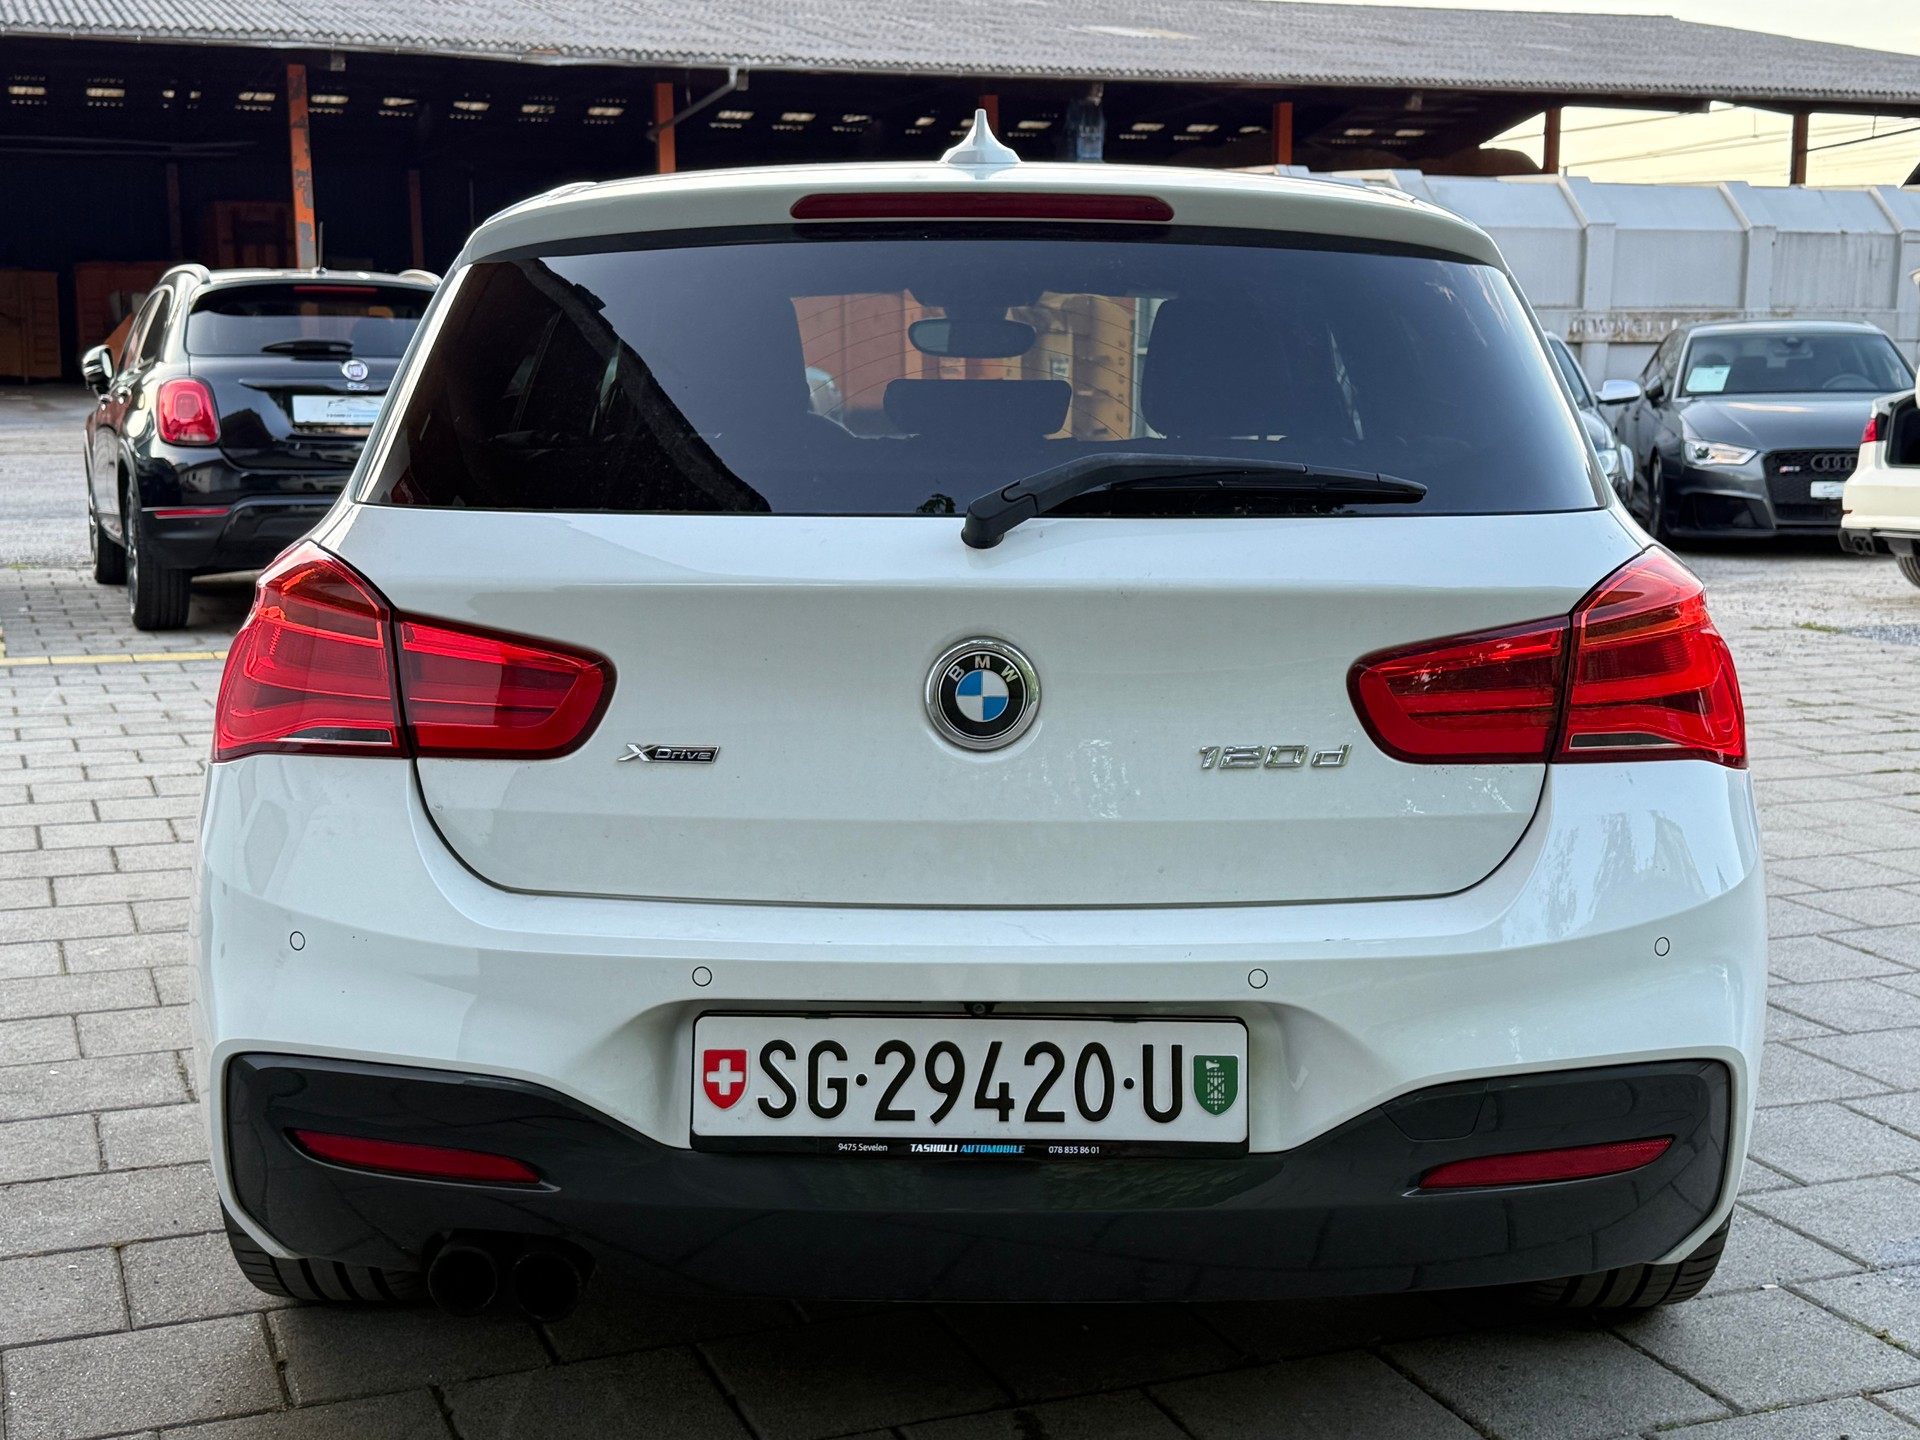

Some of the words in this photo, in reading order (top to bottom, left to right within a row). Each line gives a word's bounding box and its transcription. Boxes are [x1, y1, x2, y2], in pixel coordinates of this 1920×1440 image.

[948, 655, 1018, 683] BMW
[1199, 744, 1352, 769] 120d
[838, 1143, 857, 1152] 9475
[858, 1143, 888, 1152] Sevelen
[910, 1143, 958, 1153] TASHOLLI
[960, 1144, 1026, 1154] AUTOMOBILE
[1048, 1146, 1063, 1154] 078
[1064, 1146, 1079, 1154] 835
[1079, 1146, 1090, 1154] 86
[1090, 1146, 1100, 1154] 01
